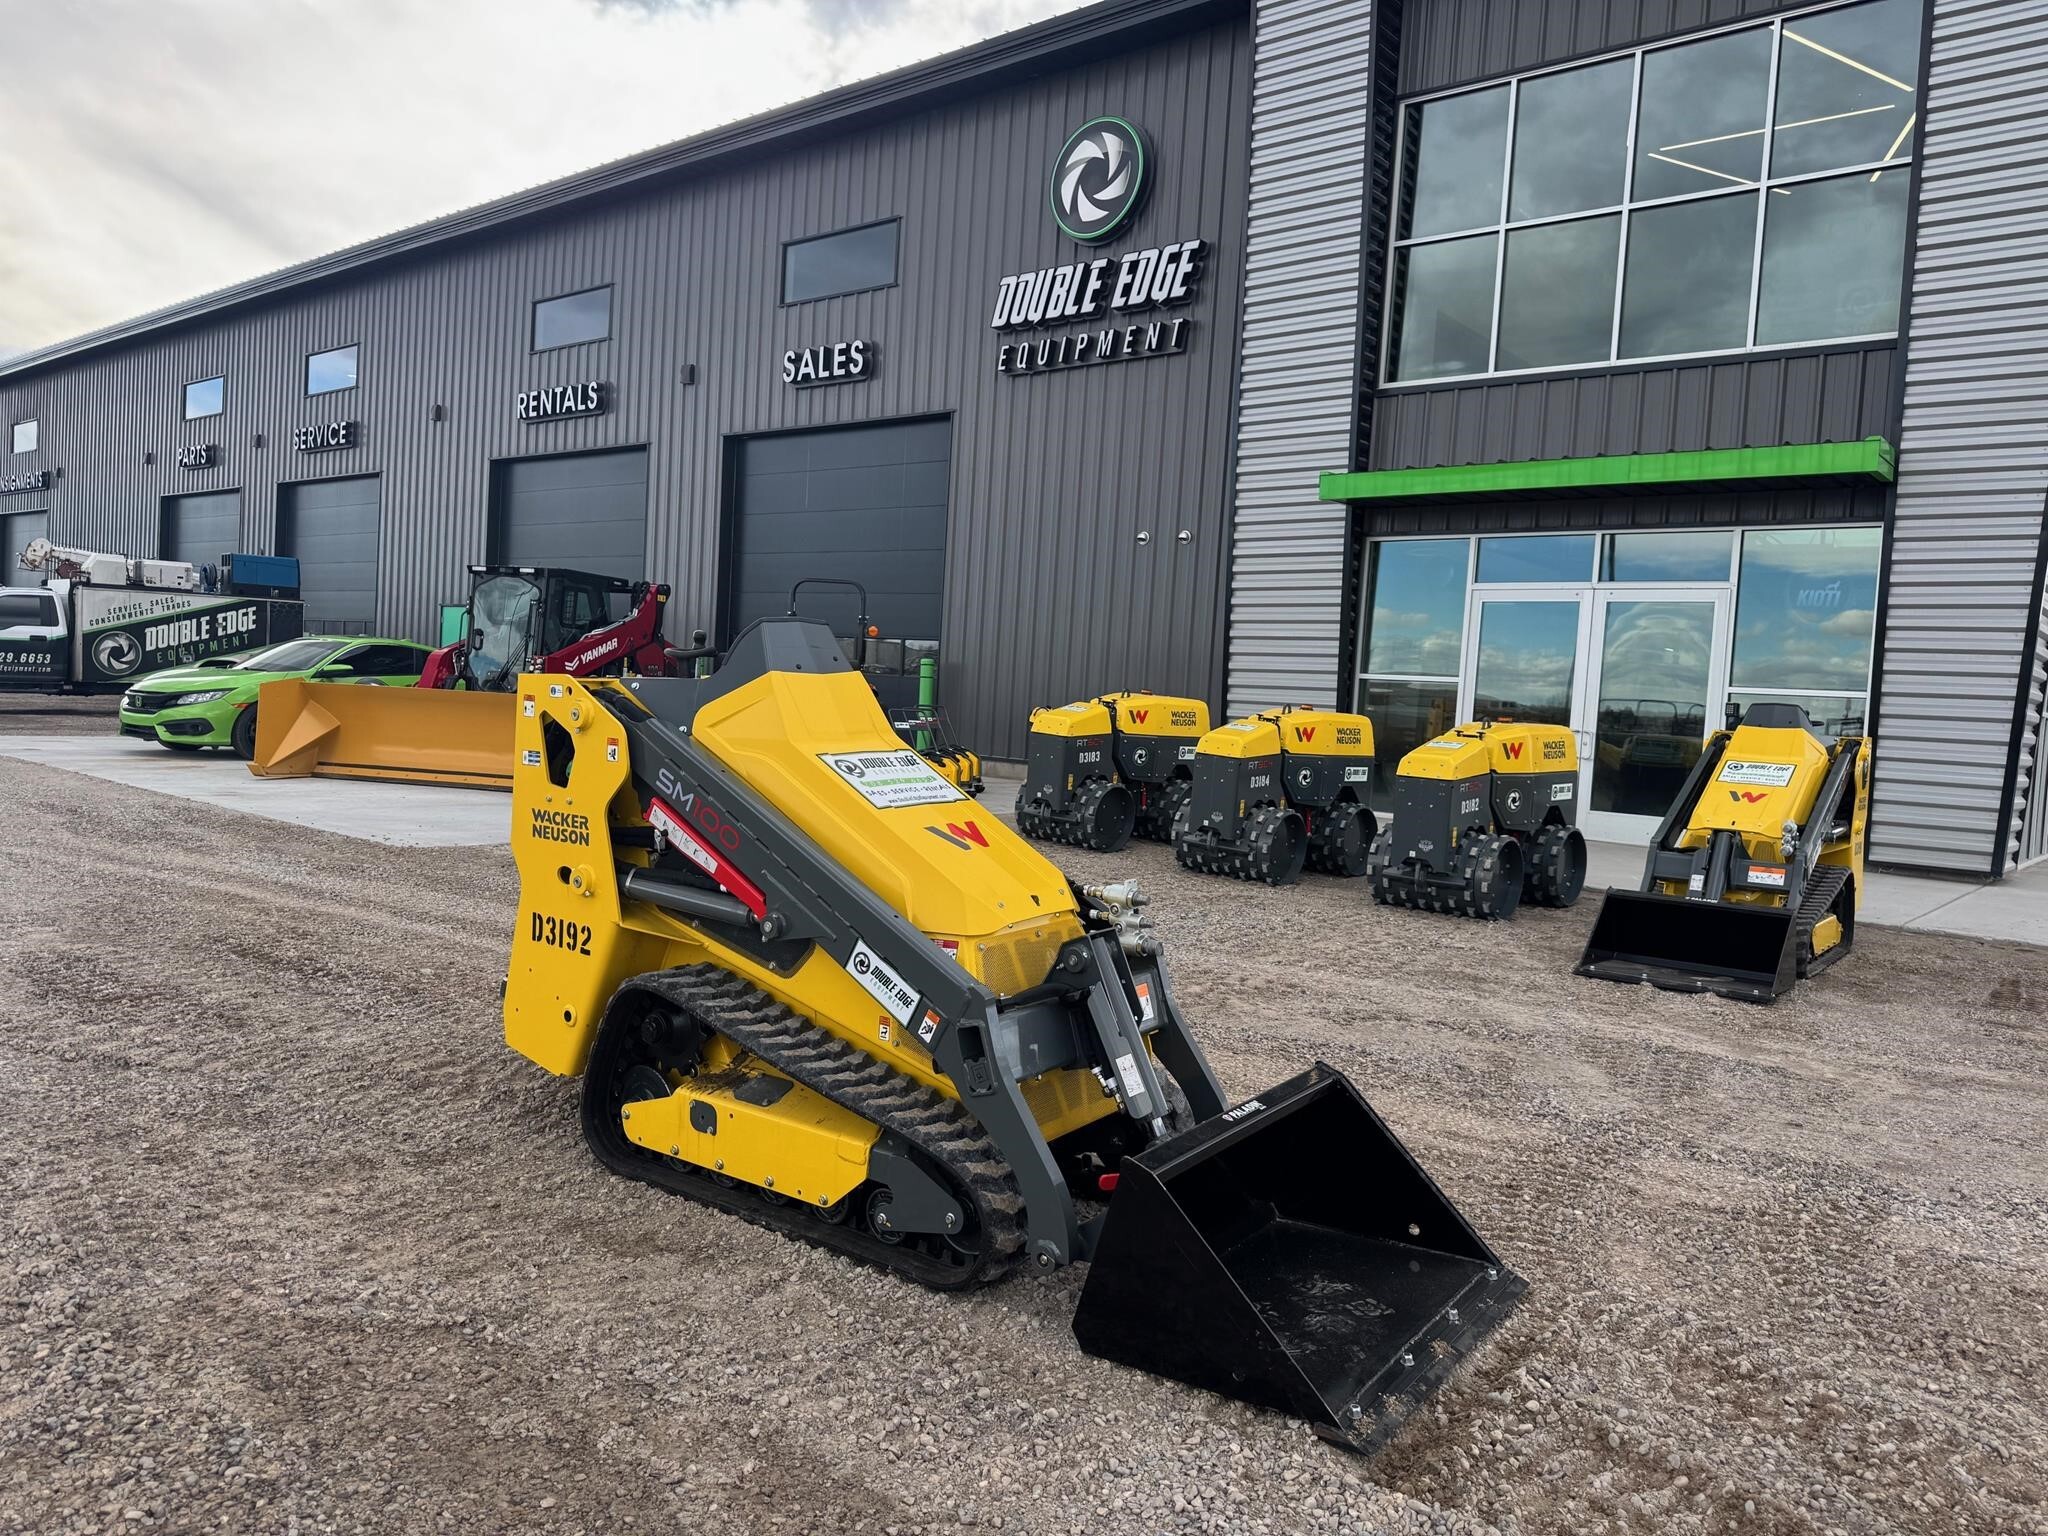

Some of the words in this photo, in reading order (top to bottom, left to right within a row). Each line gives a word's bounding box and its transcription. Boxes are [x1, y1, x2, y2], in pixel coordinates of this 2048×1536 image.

[991, 258, 1109, 328] DOUBLE
[1111, 239, 1201, 308] EDGE
[998, 318, 1184, 371] EQUIPMENT
[783, 340, 864, 384] SALES
[517, 381, 599, 419] RENTALS
[293, 421, 347, 450] SERVICE
[178, 444, 207, 466] PARTS
[108, 602, 142, 615] SERVICE
[150, 595, 175, 607] SALES
[1796, 586, 1841, 607] KIOTI
[89, 607, 154, 626] CONSIGNMENTS
[161, 600, 191, 612] TRADES
[145, 616, 210, 651] DOUBLE
[216, 607, 257, 637] EDGE
[157, 634, 249, 663] EQUIPMENT
[580, 638, 618, 664] YANMAR
[1171, 719, 1196, 727] NEUSON
[1336, 728, 1361, 736] WACKER
[1336, 736, 1361, 745] NEUSON
[1543, 740, 1565, 750] WACKER
[858, 757, 897, 769] DOUBLE
[895, 755, 920, 767] EDGE
[1079, 751, 1100, 763] D3183
[1543, 750, 1566, 759] NEUSON
[1250, 775, 1270, 788] D3184
[532, 808, 589, 831] WACKER
[656, 768, 740, 850] SM100
[532, 824, 590, 846] NEUSON
[532, 912, 592, 956] D3192
[870, 966, 898, 993] DOUBLE
[894, 988, 915, 1009] EDGE
